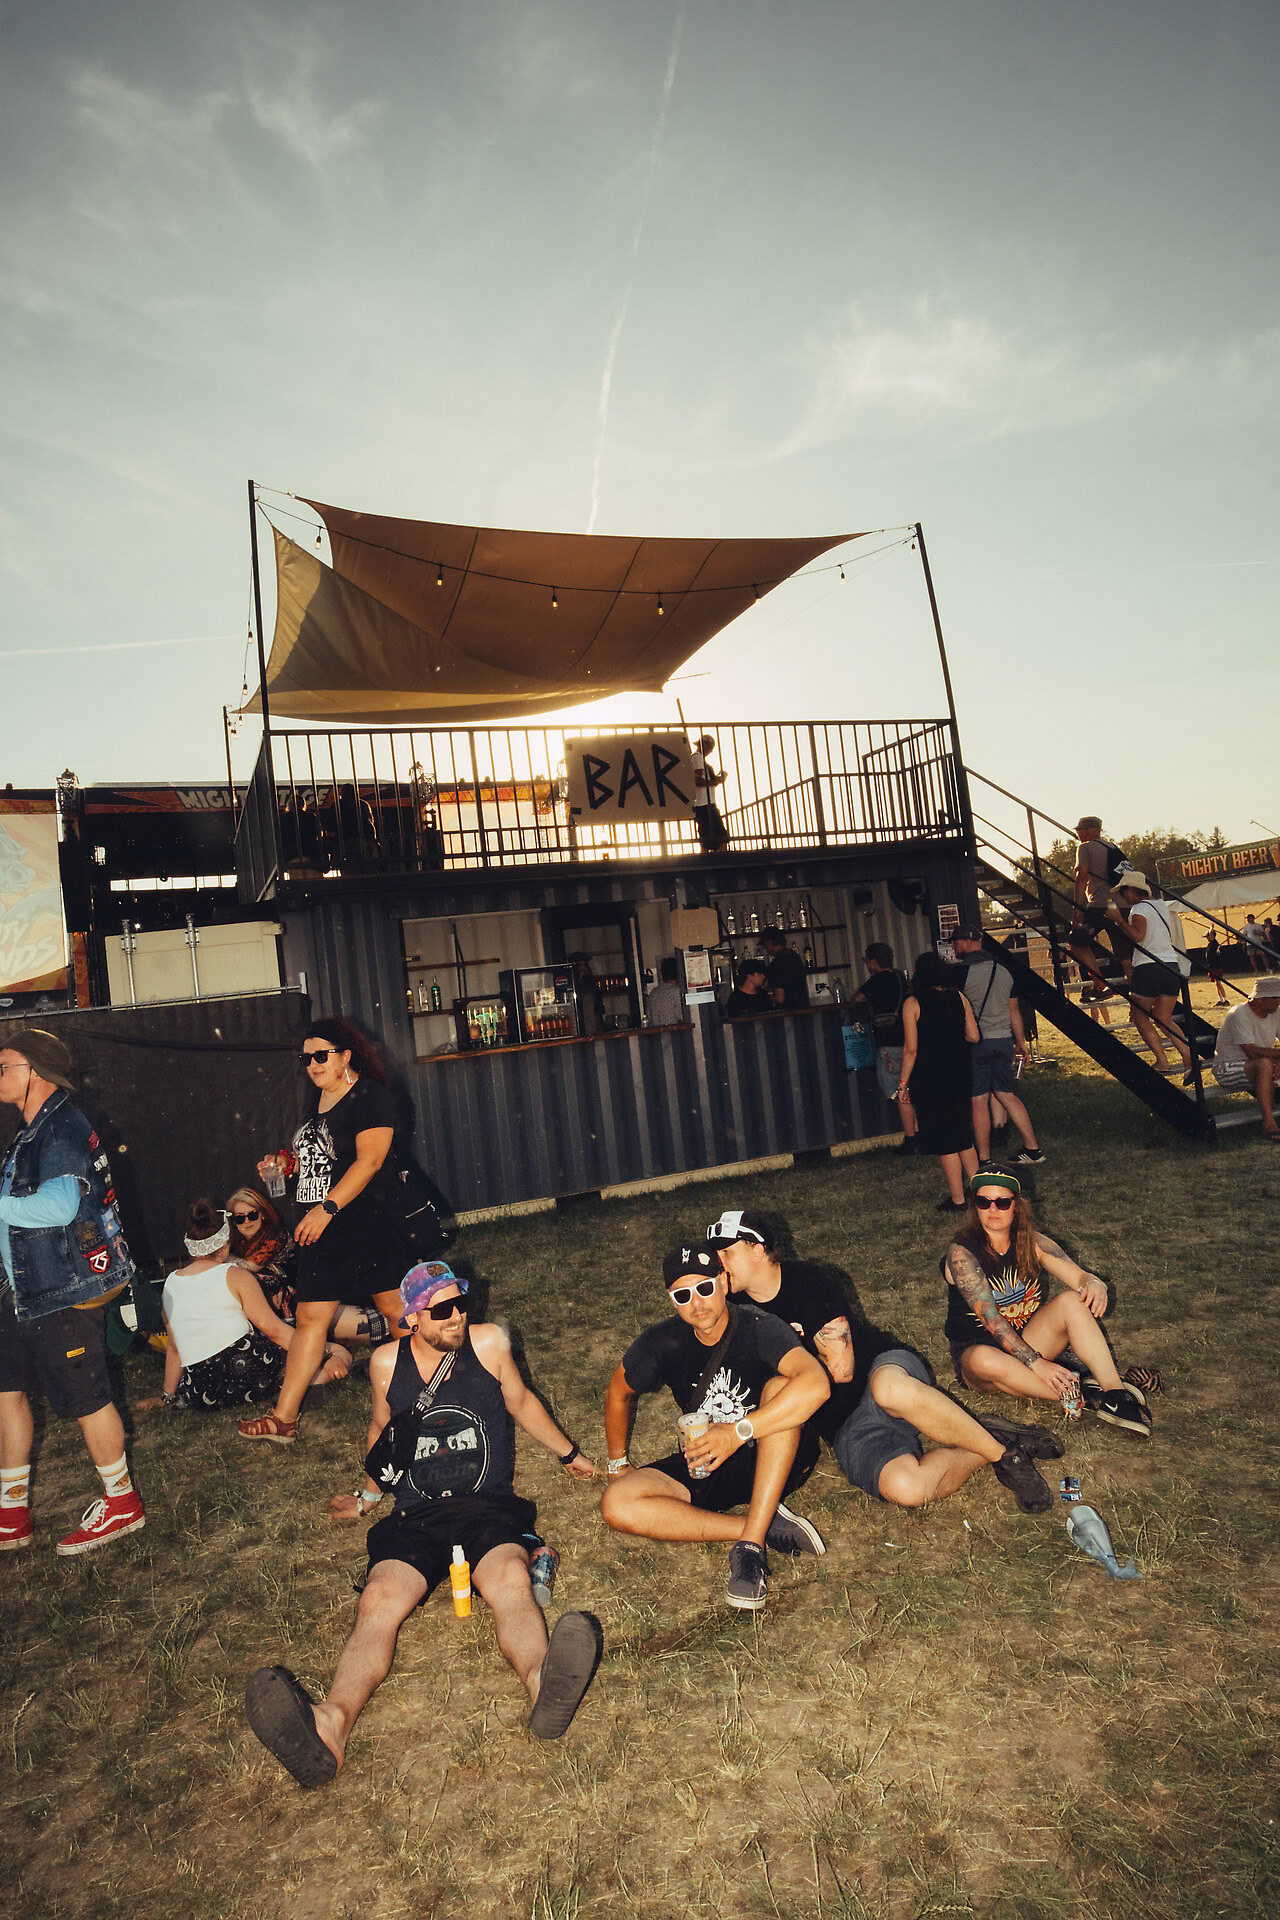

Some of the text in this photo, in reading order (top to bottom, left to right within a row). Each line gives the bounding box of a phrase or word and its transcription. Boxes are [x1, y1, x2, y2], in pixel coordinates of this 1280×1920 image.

[582, 743, 690, 810] BAR
[176, 789, 249, 809] MIGHT
[1181, 846, 1269, 878] MIGHTY BEER
[391, 1469, 404, 1486] adidas
